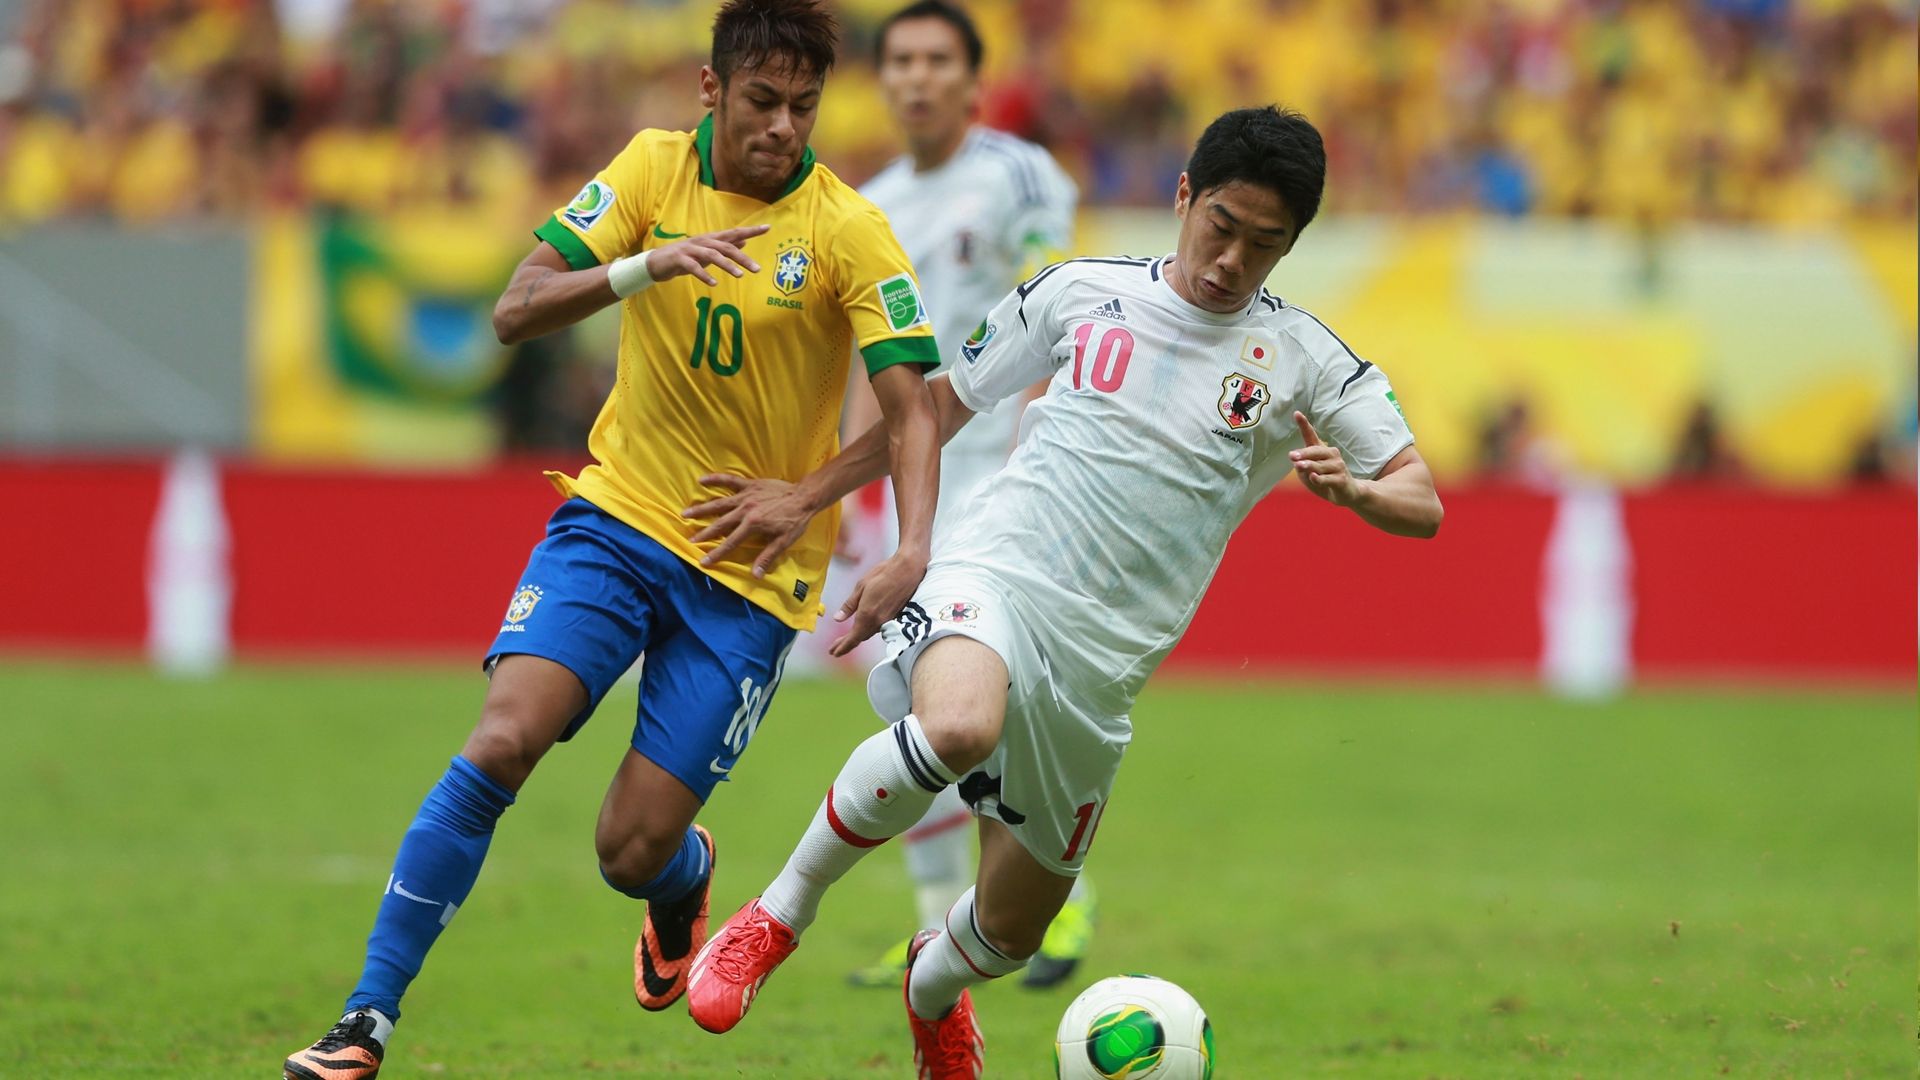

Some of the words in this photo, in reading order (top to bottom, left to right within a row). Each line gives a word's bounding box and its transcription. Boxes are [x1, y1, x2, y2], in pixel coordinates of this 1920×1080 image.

[767, 296, 804, 310] BRASIL
[1089, 309, 1127, 321] adidas
[690, 297, 743, 376] 10
[1072, 323, 1135, 393] 10
[1211, 429, 1243, 444] JAPAN
